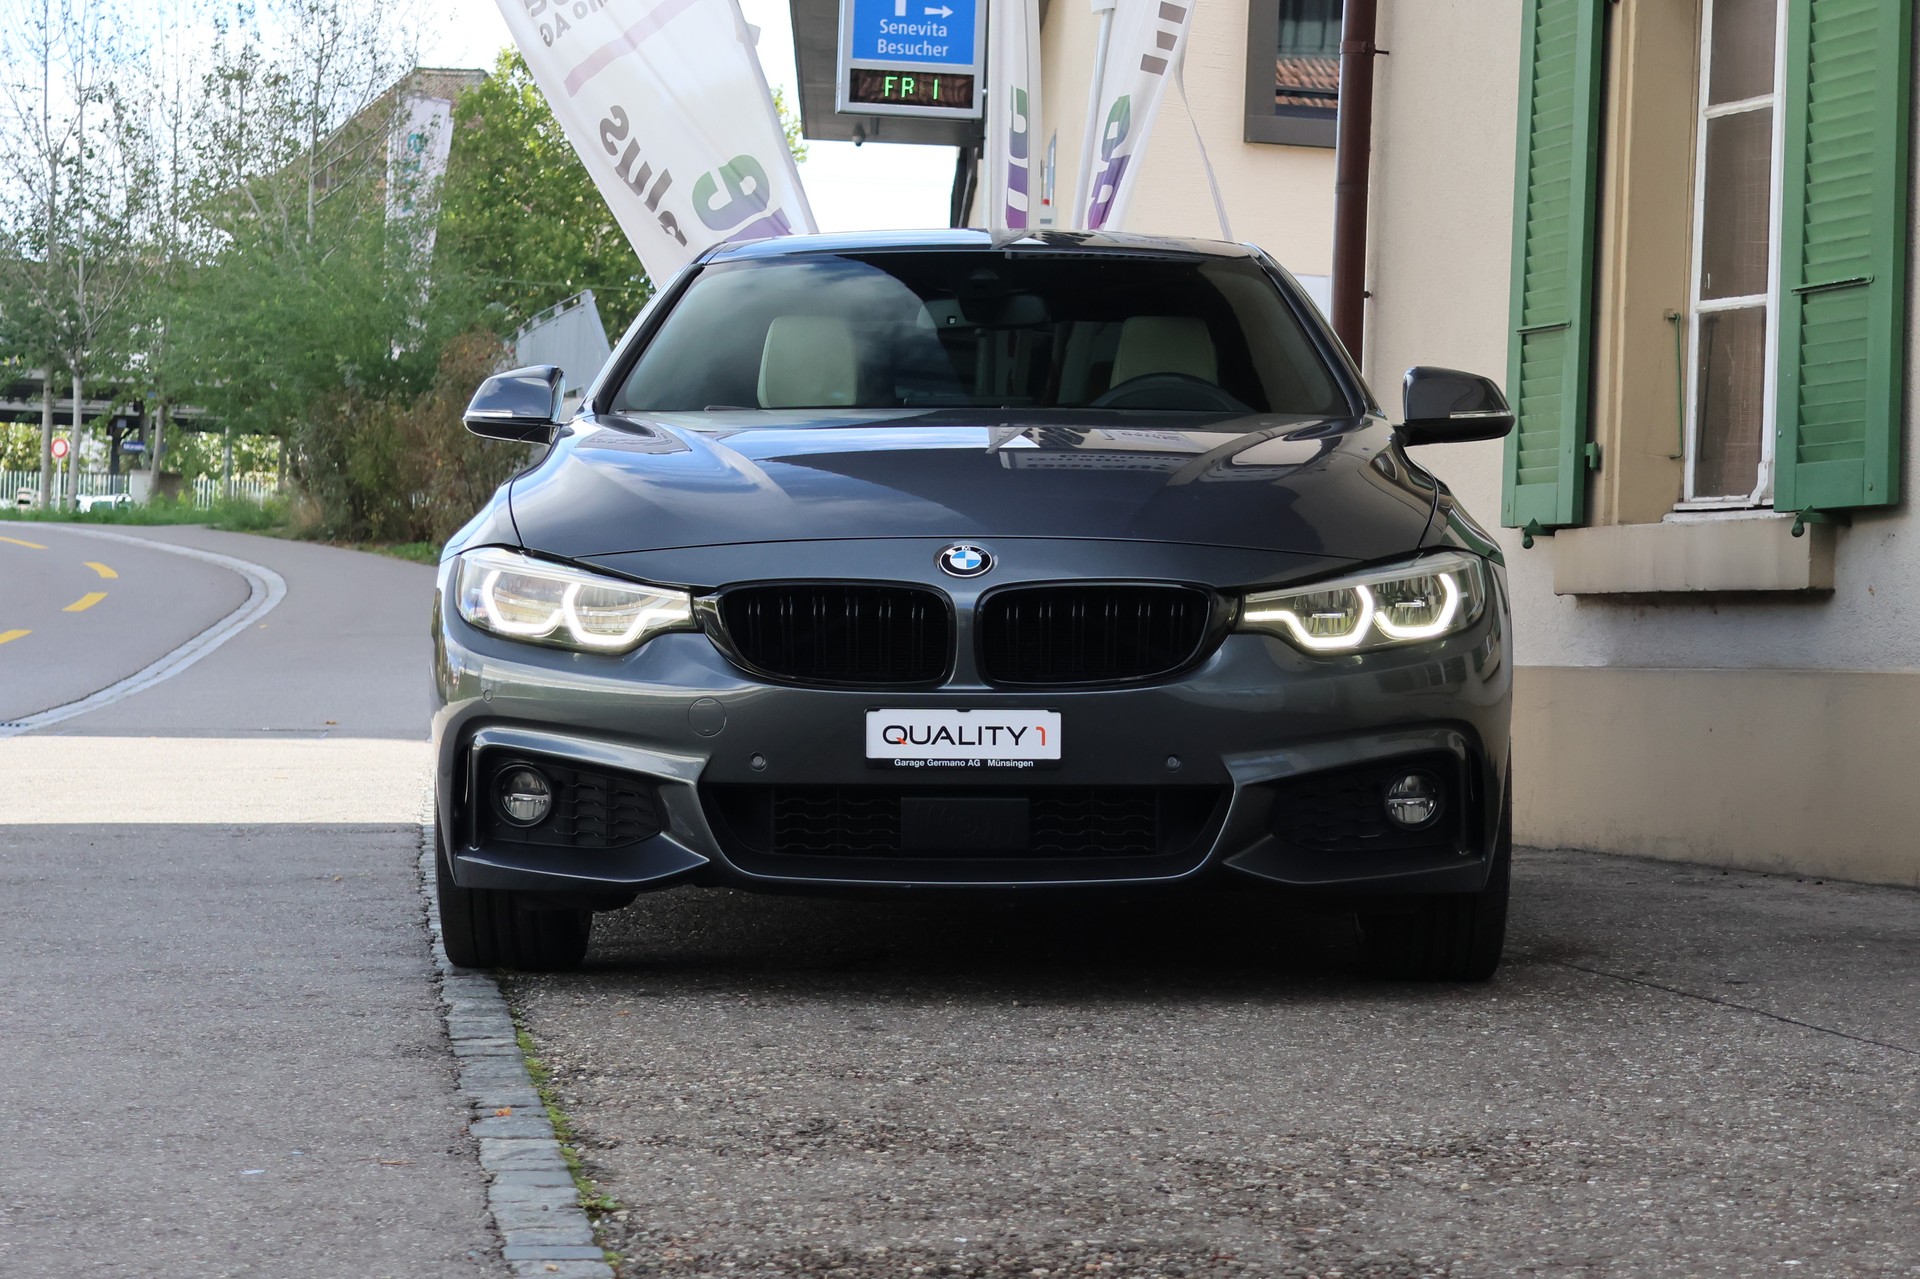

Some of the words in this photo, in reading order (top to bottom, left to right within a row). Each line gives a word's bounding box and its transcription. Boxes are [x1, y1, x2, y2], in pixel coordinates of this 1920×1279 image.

[879, 19, 947, 37] Senevita
[877, 39, 949, 57] Besucher
[882, 725, 1028, 746] QUALITY
[1035, 726, 1046, 746] 1
[894, 759, 925, 767] Garage
[927, 759, 966, 767] Germano
[968, 759, 981, 767] AG
[987, 758, 1034, 768] Münsingen
